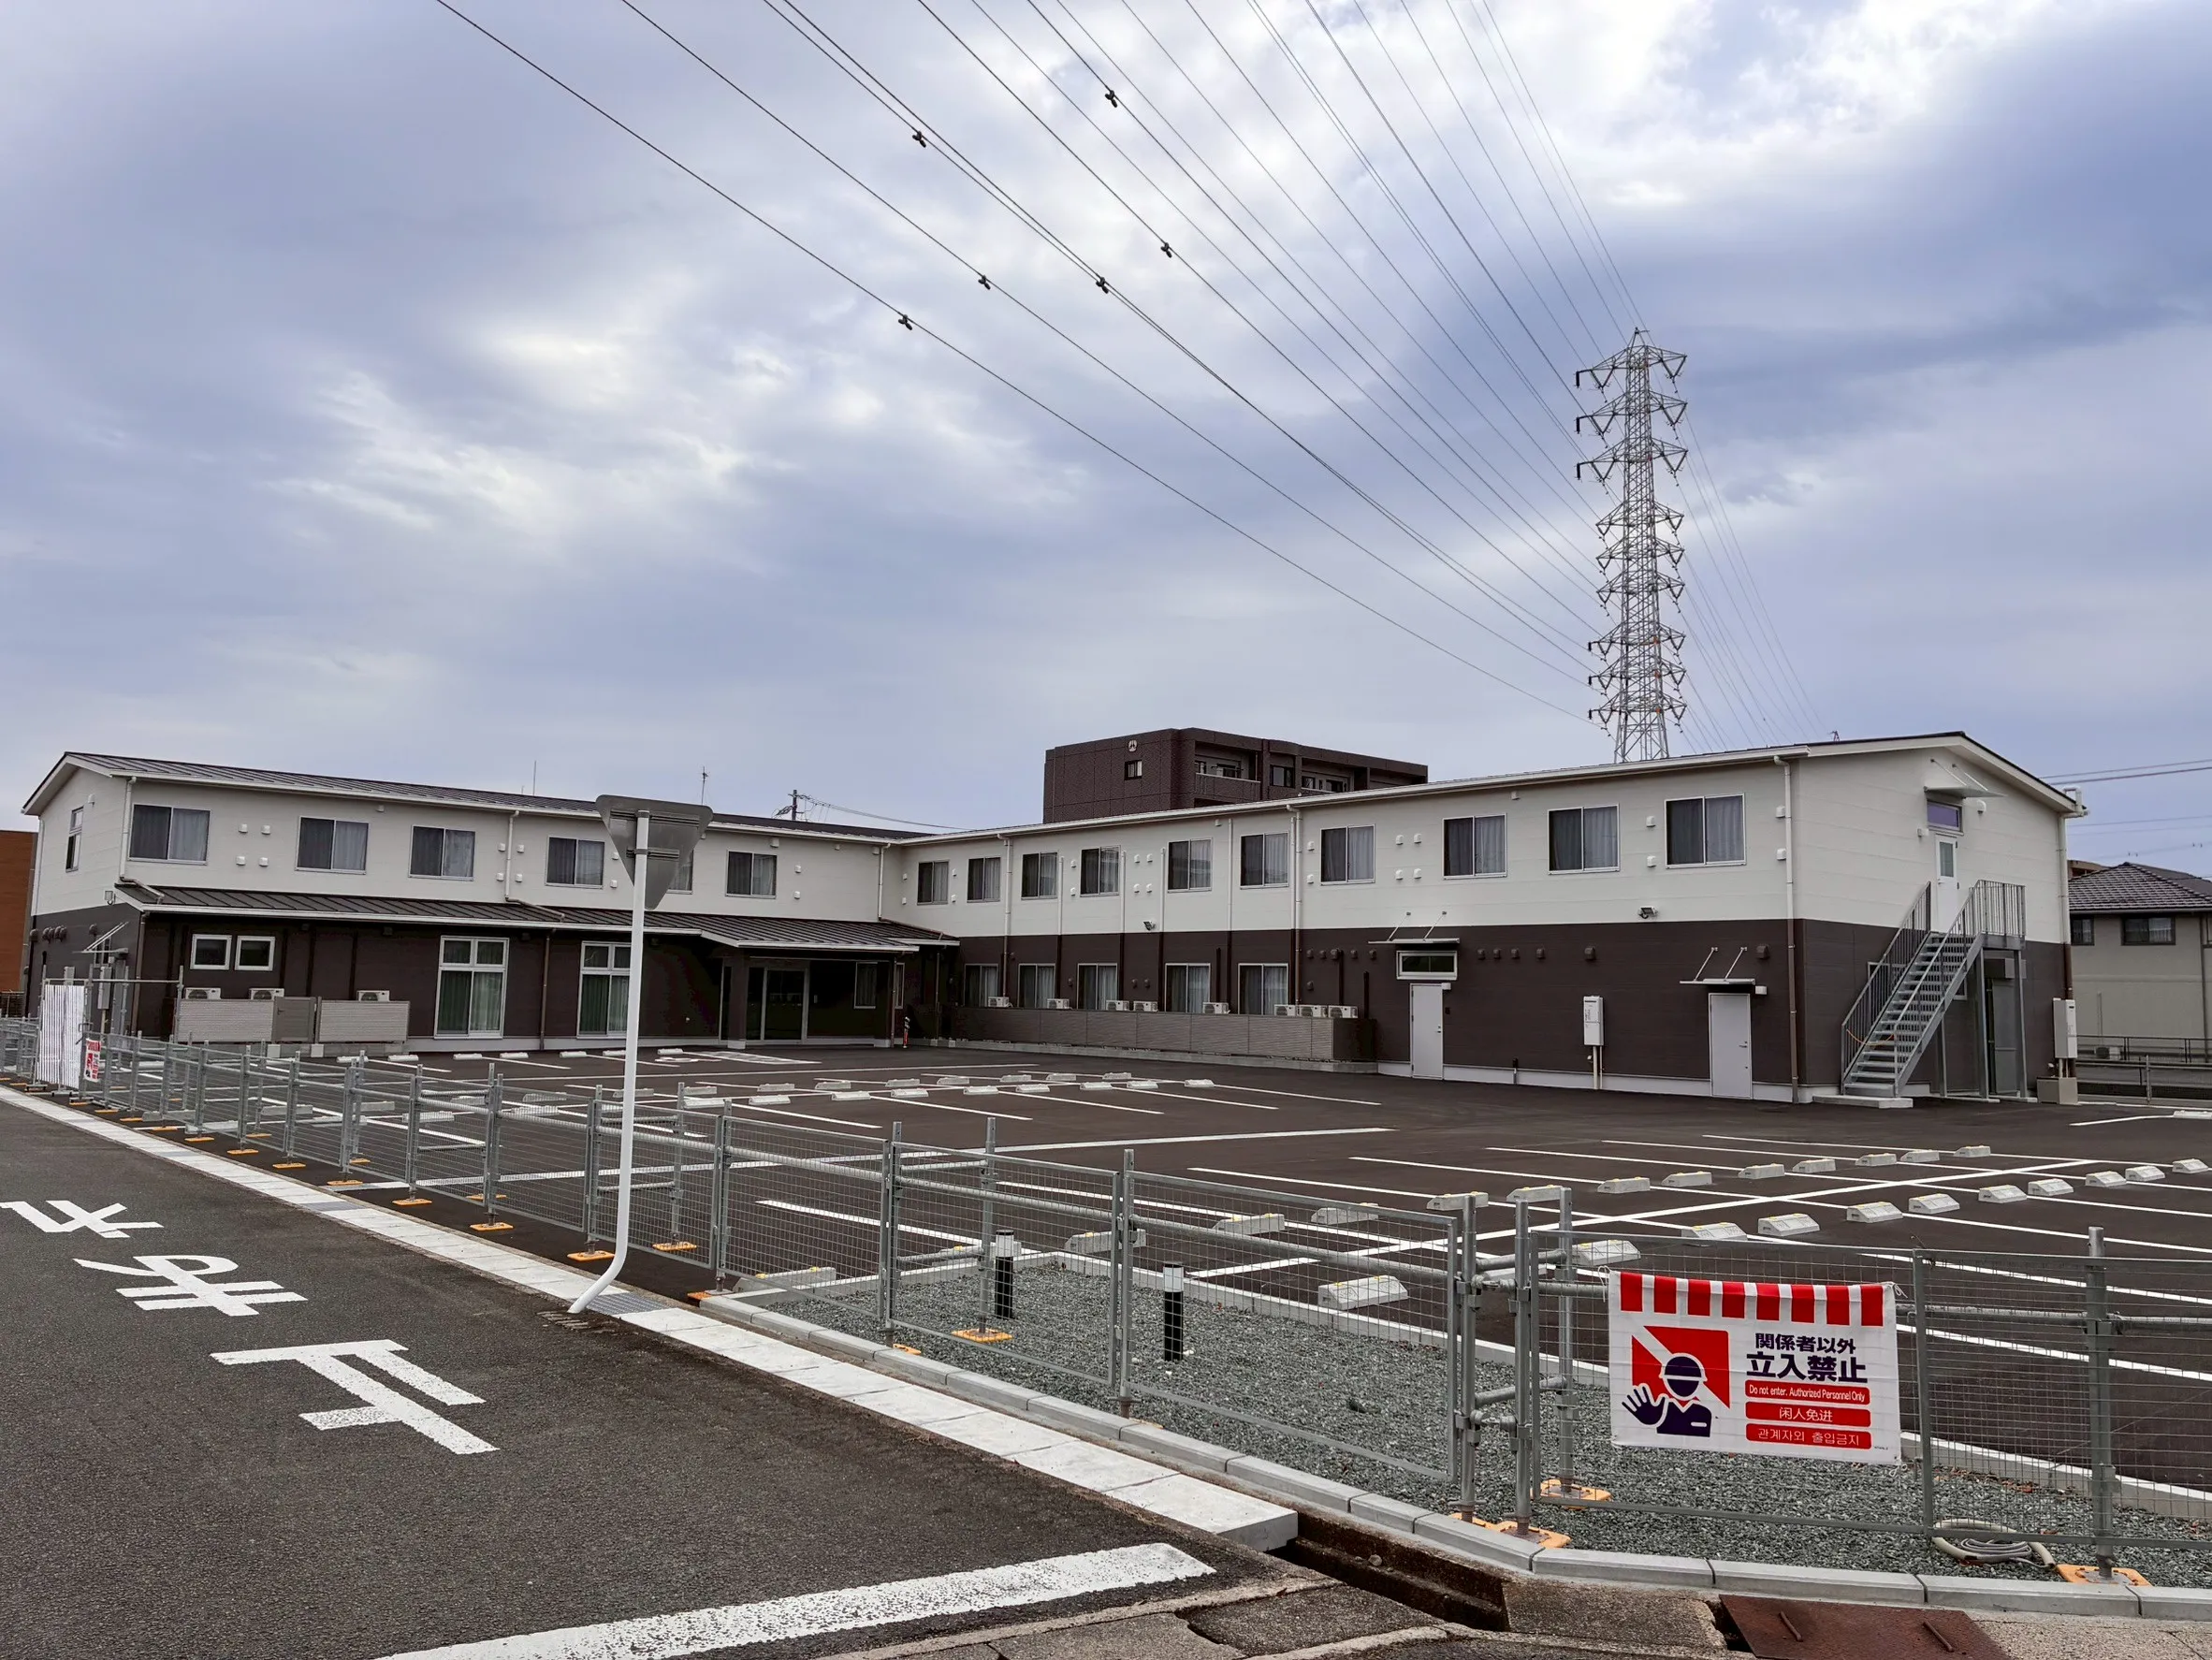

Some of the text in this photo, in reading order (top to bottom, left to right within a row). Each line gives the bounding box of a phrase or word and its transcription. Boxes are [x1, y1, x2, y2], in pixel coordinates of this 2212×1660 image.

[0, 1201, 500, 1454] 止まれ
[1755, 1332, 1856, 1354] 関係者以外
[1746, 1351, 1868, 1383] 立入禁止
[1749, 1384, 1865, 1403] Do not enter. Authorized Personnel Only
[1779, 1406, 1833, 1422] 闲人免进
[1757, 1428, 1859, 1446] 관계자외 출입금지
